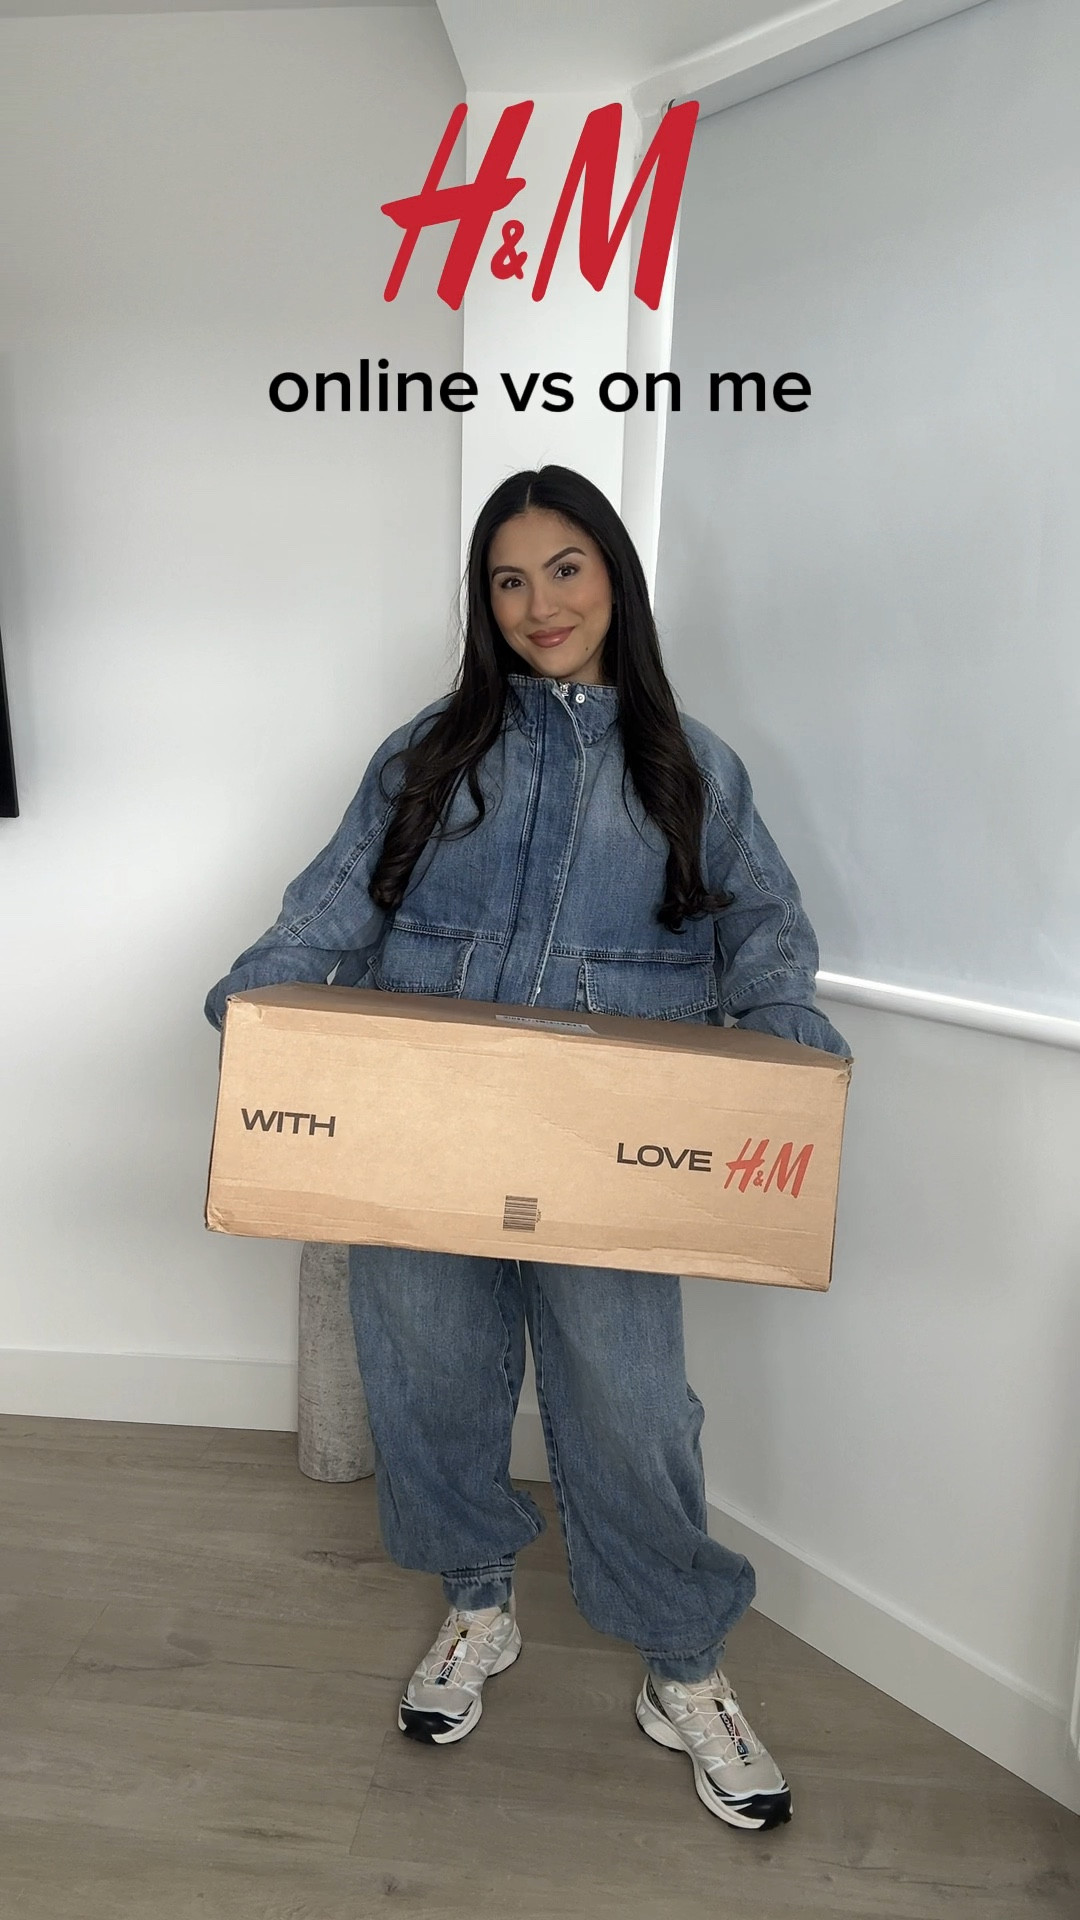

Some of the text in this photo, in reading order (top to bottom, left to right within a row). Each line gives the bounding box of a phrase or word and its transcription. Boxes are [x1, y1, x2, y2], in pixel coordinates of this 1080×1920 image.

[241, 1108, 814, 1199] WITH LOVE H&M
